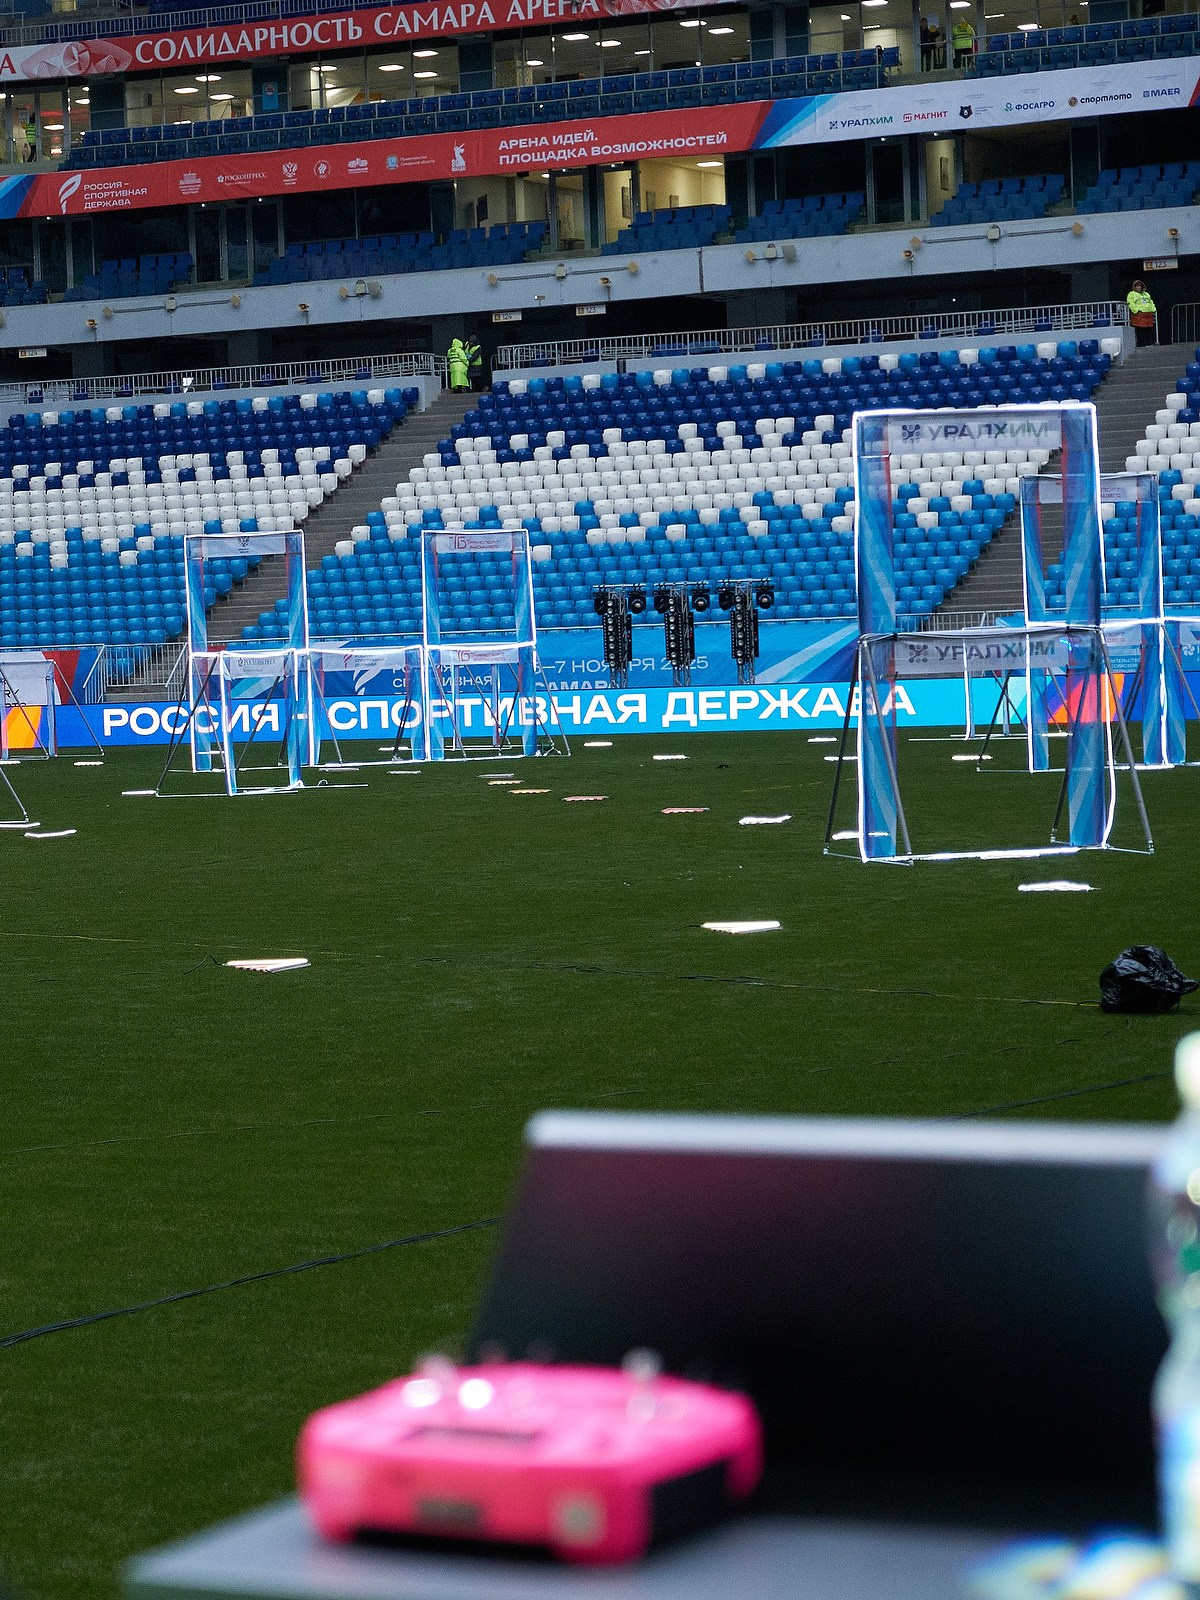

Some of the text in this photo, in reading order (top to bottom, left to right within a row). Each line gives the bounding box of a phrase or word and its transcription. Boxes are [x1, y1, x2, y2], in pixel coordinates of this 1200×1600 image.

[134, 17, 363, 64] СОЛИДАРНОСТЬ
[374, 1, 496, 37] САМАРА
[1015, 101, 1055, 111] ФОСАГРО
[840, 116, 893, 128] УРАЛХИМ
[914, 111, 948, 121] МАГНИТ
[499, 130, 599, 150] АРЕНА ИДЕЙ.
[499, 131, 727, 165] ПЛОЩАДКА ВОЗМОЖНОСТЕЙ
[84, 181, 122, 191] РОССИЯ
[84, 188, 148, 200] СПОРТИВНАЯ
[84, 199, 131, 210] ДЕРЖАВА
[928, 422, 1048, 441] УРАЛХИМ
[935, 641, 1055, 661] УРАЛХИМ
[572, 657, 655, 673] НОЯРЯ
[103, 703, 279, 737] РОССИЯ
[328, 694, 647, 730] СПОРТИВНАЯ
[661, 685, 916, 728] ДЕРЖАВА
